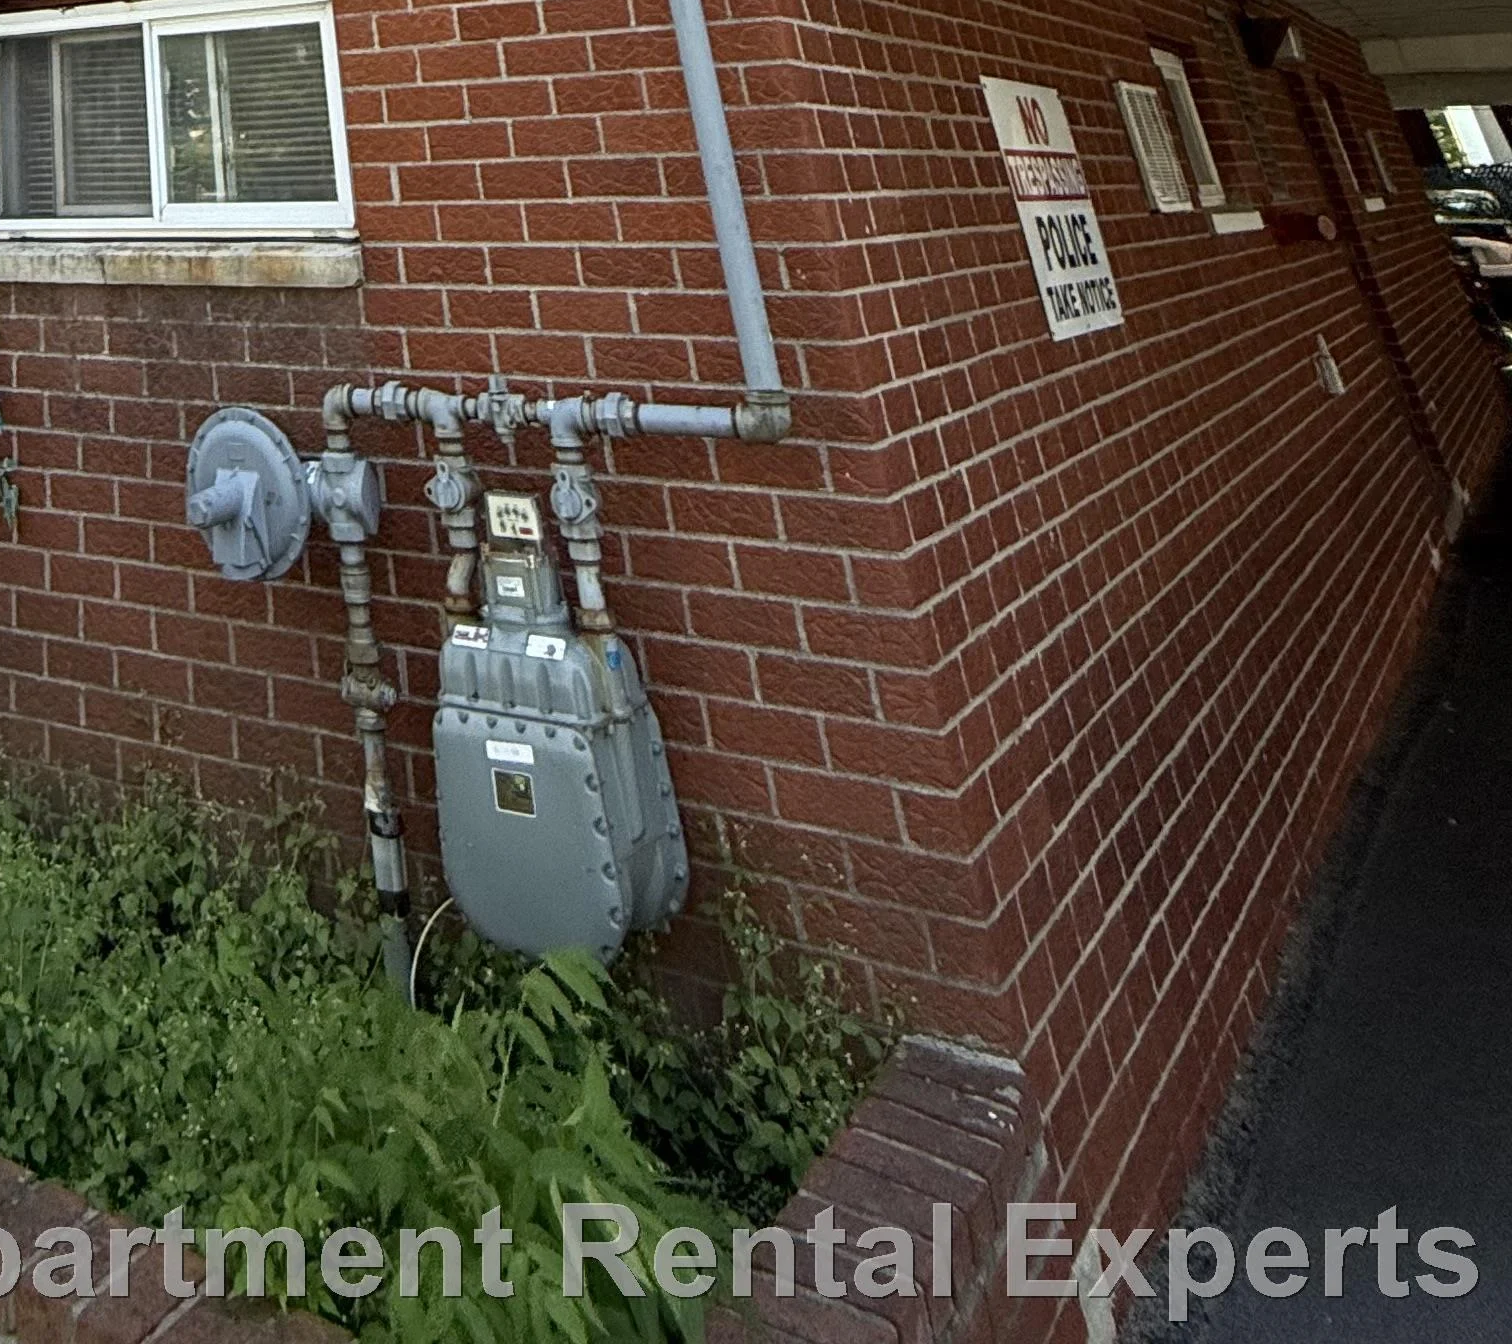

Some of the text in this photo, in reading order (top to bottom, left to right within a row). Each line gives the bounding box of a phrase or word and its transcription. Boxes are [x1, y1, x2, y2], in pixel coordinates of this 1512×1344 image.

[1015, 95, 1050, 147] NO
[1035, 213, 1099, 272] POLICE
[1046, 276, 1118, 323] TAKE NOTICE
